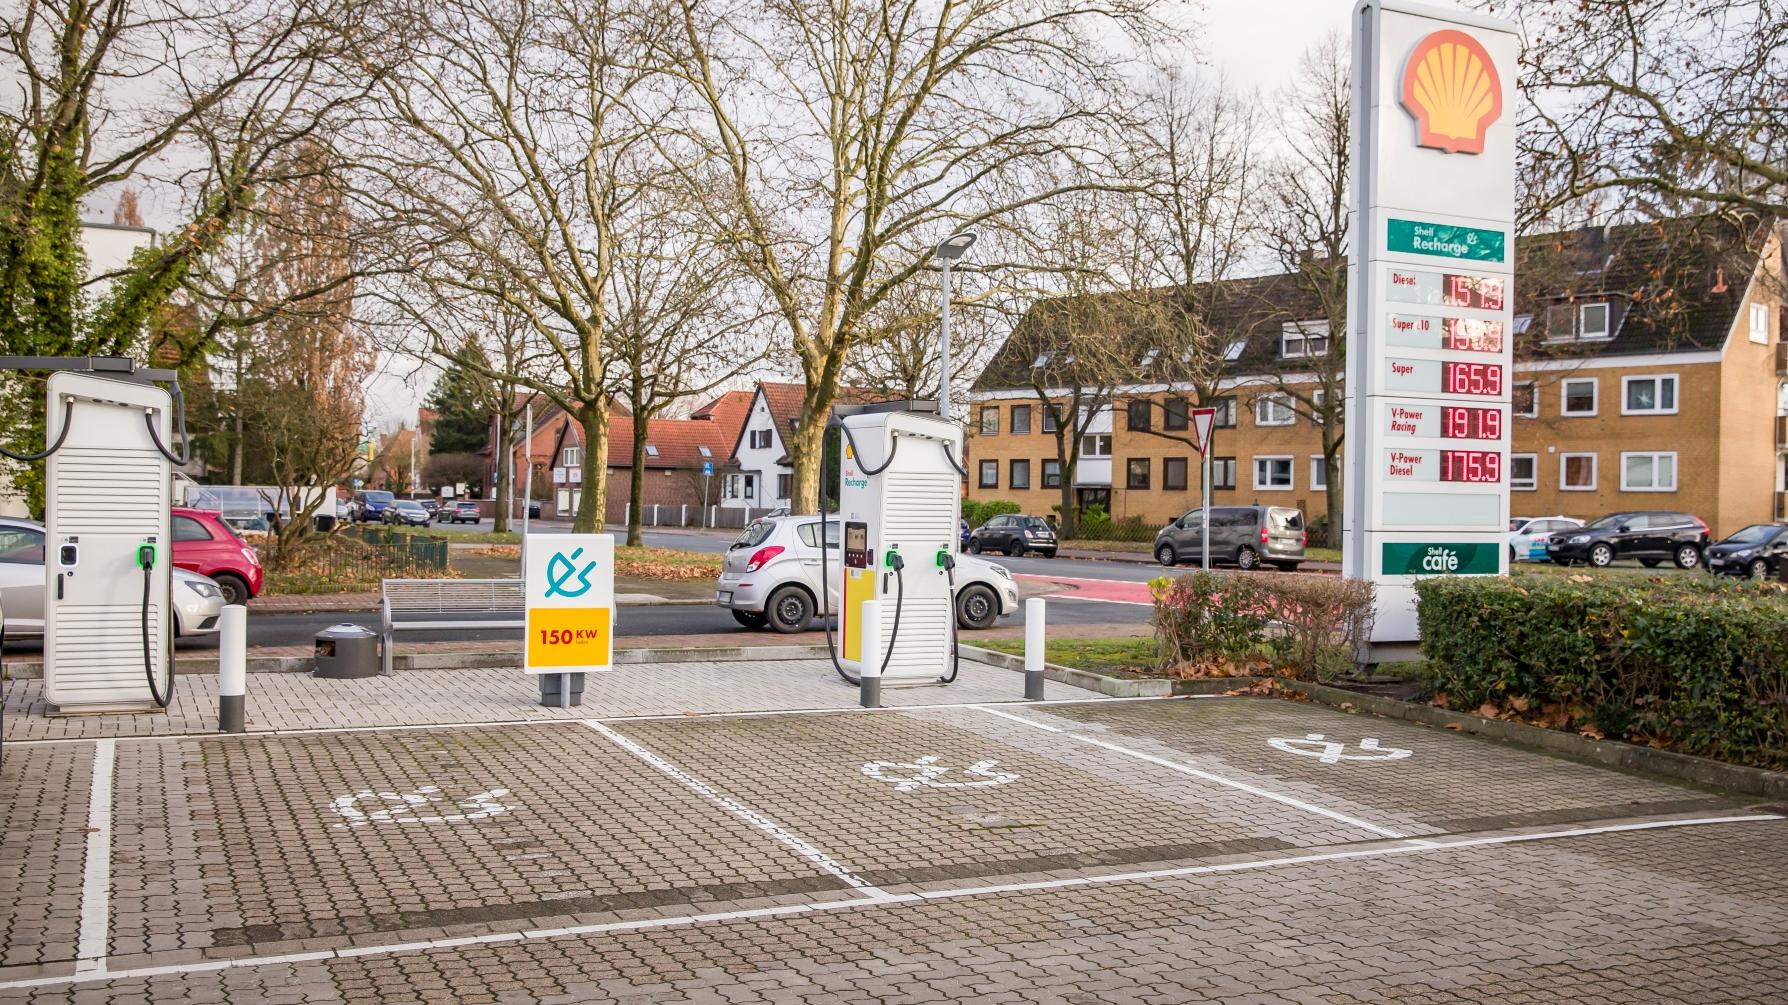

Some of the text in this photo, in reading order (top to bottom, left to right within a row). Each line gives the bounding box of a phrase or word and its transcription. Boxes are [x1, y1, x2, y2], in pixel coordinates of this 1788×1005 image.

[1414, 226, 1434, 237] Shell
[1413, 237, 1469, 256] Recharge
[1393, 273, 1416, 286] Diesel
[1392, 318, 1414, 332] Super
[1392, 362, 1413, 376] Super
[1448, 363, 1500, 394] 165.9
[1391, 408, 1423, 420] V-Power
[1391, 420, 1416, 435] Racing
[1447, 408, 1500, 439] 191.9
[1390, 453, 1422, 464] V-Power
[1390, 464, 1413, 476] Diesel
[1446, 451, 1499, 482] 175.9
[845, 477, 868, 488] Recharge
[1427, 547, 1443, 556] Shell
[1422, 549, 1458, 571] café
[540, 629, 598, 645] 150 KW
